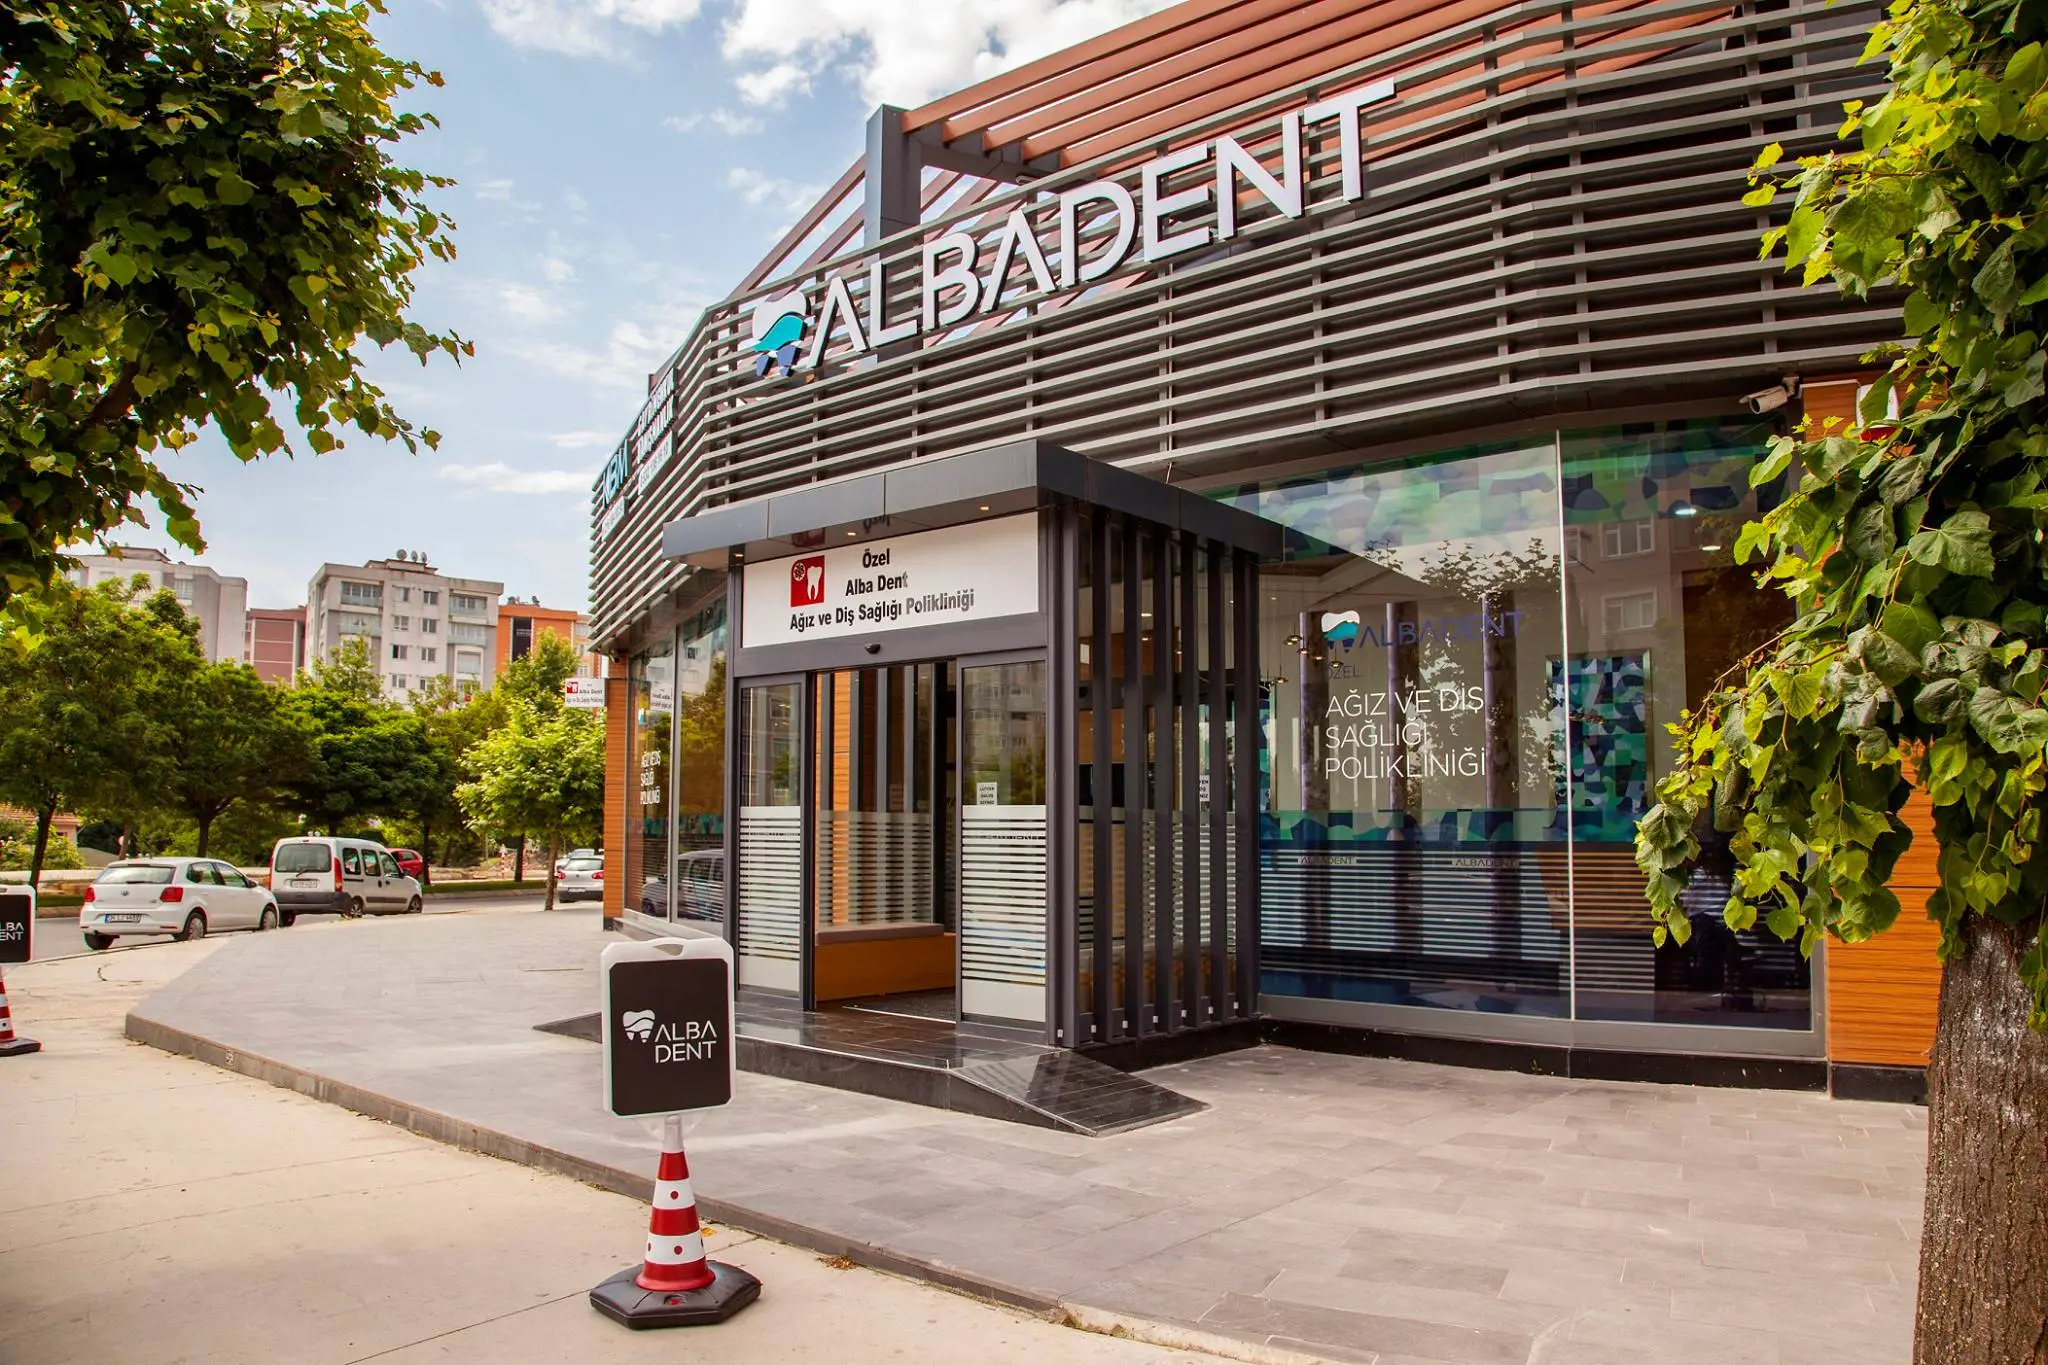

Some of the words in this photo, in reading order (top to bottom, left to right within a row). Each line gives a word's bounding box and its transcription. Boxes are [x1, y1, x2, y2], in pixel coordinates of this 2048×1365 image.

[808, 76, 1397, 368] ALBADENT
[862, 548, 890, 569] Özel
[845, 577, 873, 597] Alba
[877, 571, 908, 593] Dent
[790, 612, 815, 632] Ağız
[818, 611, 832, 625] ve
[836, 606, 854, 626] Diş
[858, 600, 902, 623] Sağlığı
[906, 588, 975, 615] Polikliniği
[1359, 611, 1527, 649] ALBADENT
[1325, 689, 1386, 718] AĞIZ
[1395, 690, 1432, 714] VE
[1439, 683, 1484, 714] DİŞ
[1325, 717, 1427, 749] SAĞLIĞI
[1325, 747, 1486, 780] POLİKLİNİĞİ
[0, 921, 24, 932] LBA
[0, 931, 24, 941] ENT
[654, 1020, 717, 1043] ALBA
[655, 1040, 717, 1064] DENT
